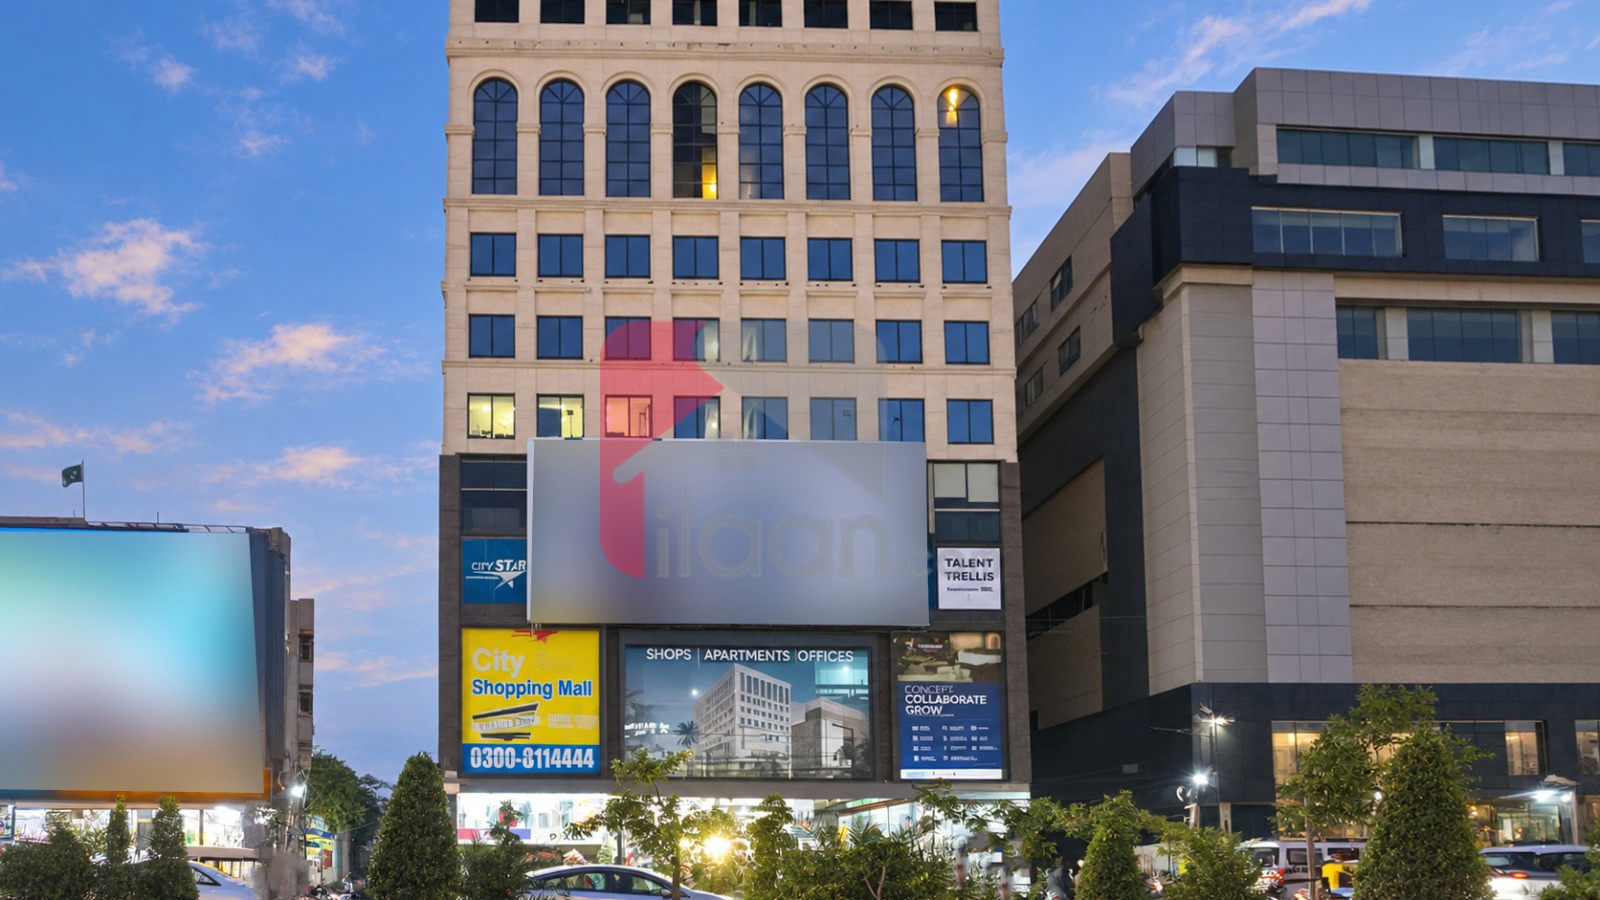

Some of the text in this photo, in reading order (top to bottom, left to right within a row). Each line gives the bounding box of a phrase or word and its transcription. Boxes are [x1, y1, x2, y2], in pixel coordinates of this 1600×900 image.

[471, 559, 526, 572] CITY STAR
[944, 558, 994, 568] TALENT
[944, 571, 995, 581] TRELLIS
[646, 648, 854, 663] SHOPS APARTMENTS OFFICES
[472, 647, 525, 679] City
[471, 678, 593, 700] Shopping Mall
[904, 694, 987, 705] COLLABORATE
[905, 705, 943, 716] GROW
[470, 746, 594, 769] 0300-8114444
